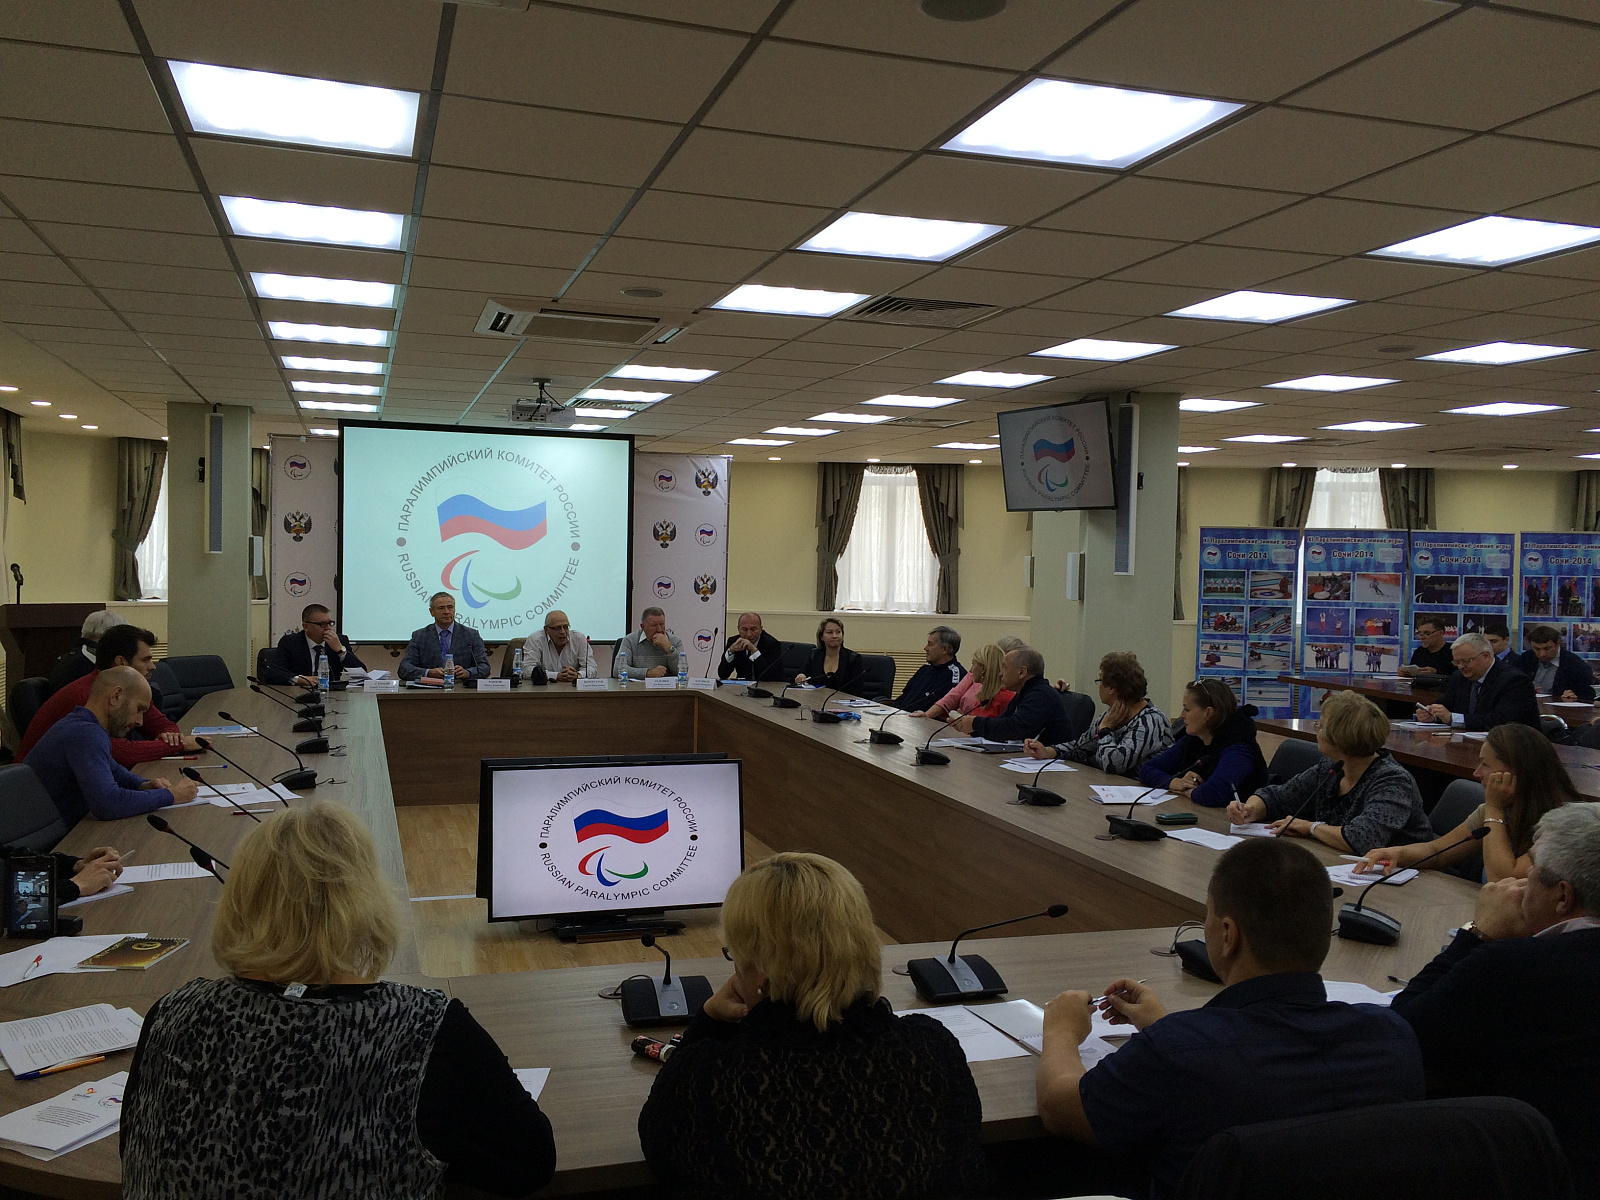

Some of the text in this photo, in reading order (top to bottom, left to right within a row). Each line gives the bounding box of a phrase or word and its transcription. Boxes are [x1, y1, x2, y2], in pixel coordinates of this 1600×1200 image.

[398, 447, 581, 539] ПАРАЛИМПИЙСКИЙ КОМИТЕТ РОССИИ
[1070, 463, 1091, 497] COMMITTEE
[454, 612, 523, 630] RALYMPIC
[526, 557, 580, 621] COMMITTEE
[540, 775, 698, 839] ПАРАЛИМПИЙСКИЙ КОМИТЕТ РОССИИ
[540, 844, 698, 901] RUSSIAN PARALYMPIC COMMITTEE
